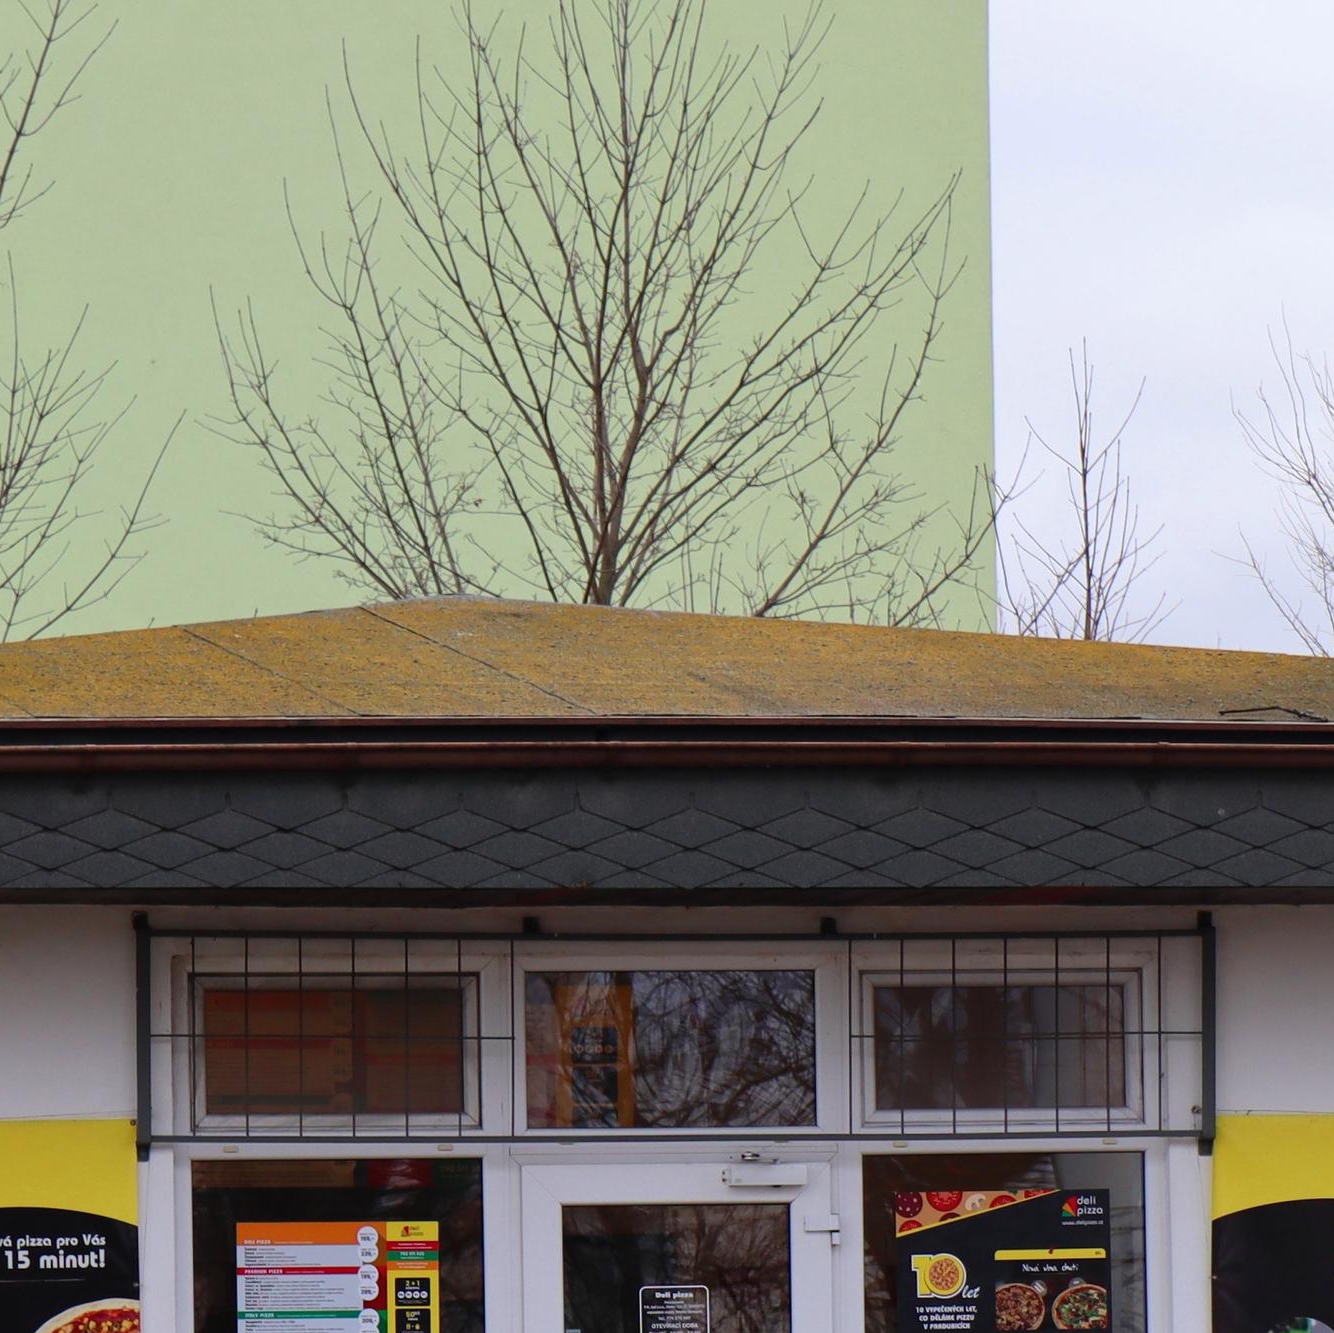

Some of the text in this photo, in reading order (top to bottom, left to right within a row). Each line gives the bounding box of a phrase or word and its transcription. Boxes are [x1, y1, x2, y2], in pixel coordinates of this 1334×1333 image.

[1077, 1196, 1096, 1204] deli
[1077, 1207, 1103, 1216] pizza
[17, 1235, 51, 1249] pizza
[56, 1236, 78, 1249] pro
[82, 1234, 106, 1246] Vás
[5, 1250, 30, 1269] 15
[39, 1249, 105, 1269] minut!
[962, 1285, 980, 1298] let
